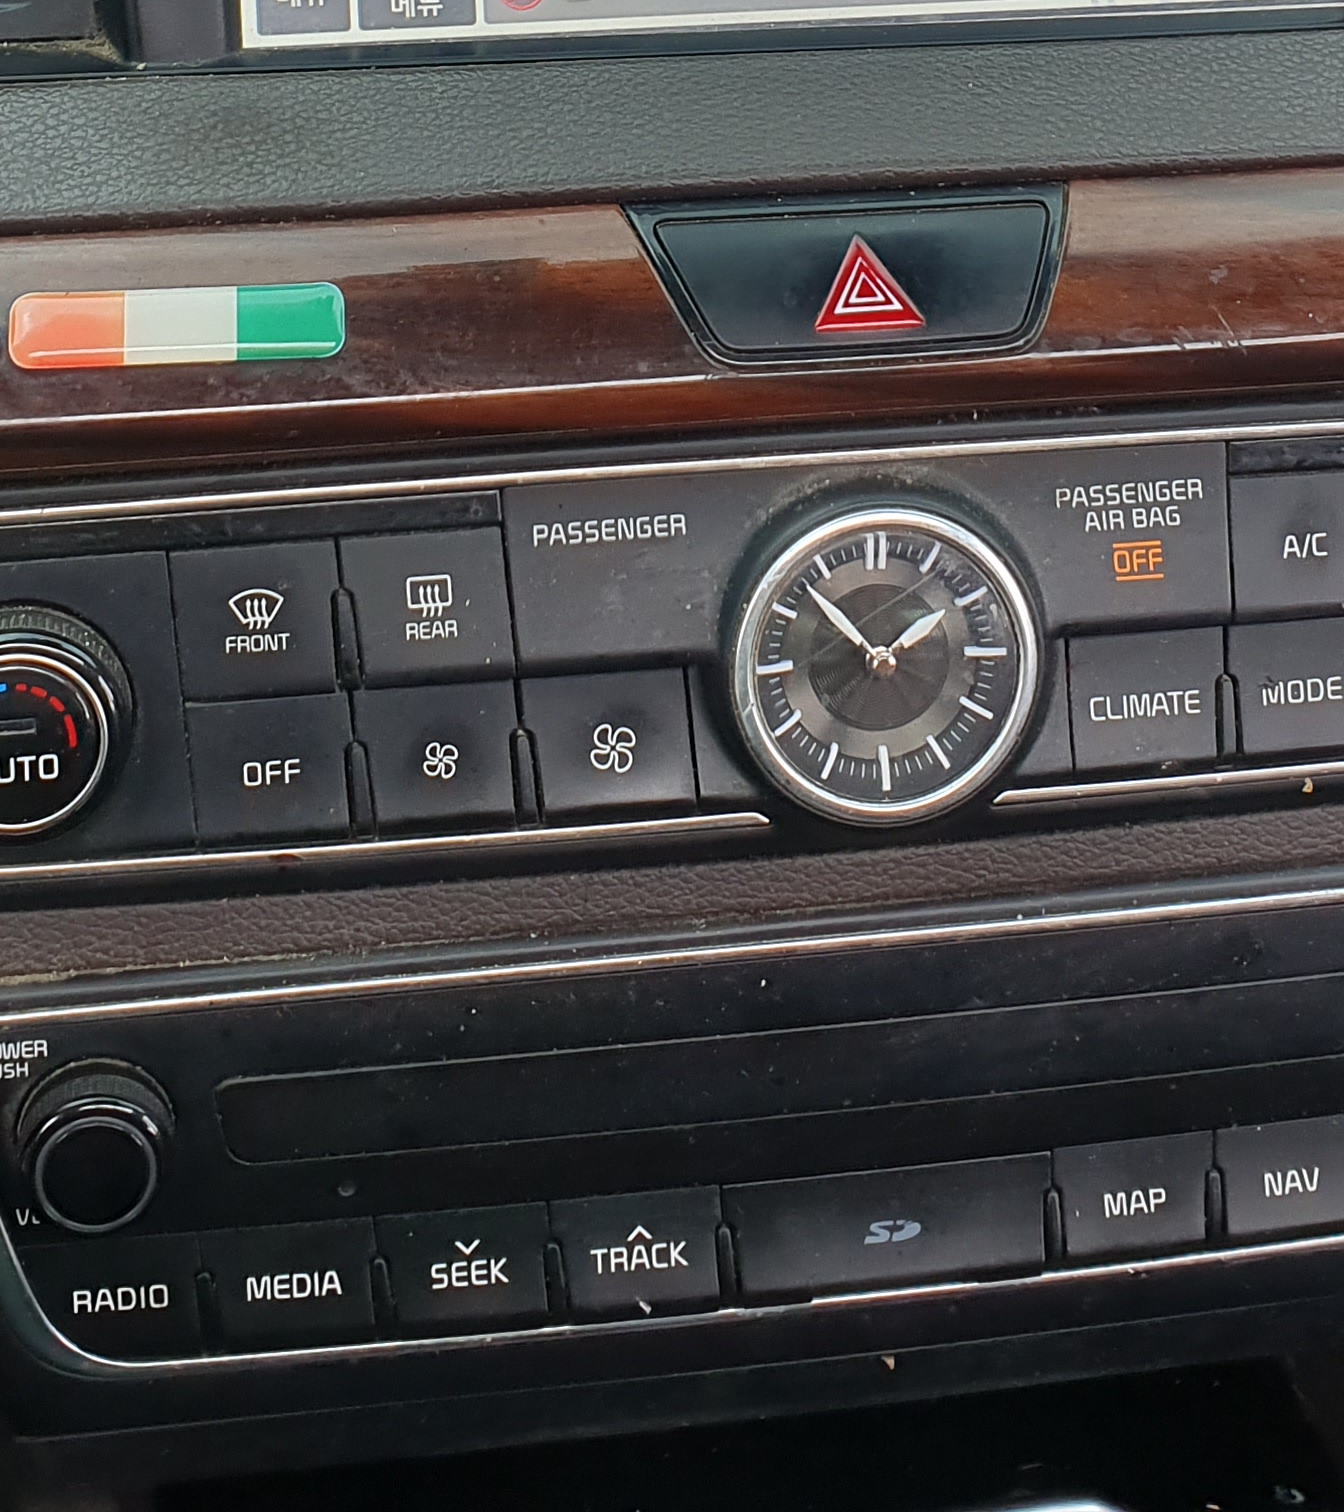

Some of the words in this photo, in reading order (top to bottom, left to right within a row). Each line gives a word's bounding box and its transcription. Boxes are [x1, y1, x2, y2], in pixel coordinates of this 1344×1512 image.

[1056, 478, 1203, 509] PASSENGER
[532, 514, 687, 547] PASSENGER
[1085, 510, 1125, 532] AIR
[1132, 506, 1181, 529] BAG
[1283, 532, 1329, 559] A/C
[1113, 548, 1163, 574] OFF
[225, 633, 290, 654] FRONT
[405, 620, 458, 641] REAR
[1089, 690, 1202, 722] CLIMATE
[1262, 676, 1343, 707] MODE
[243, 759, 302, 787] OFF
[1263, 1167, 1320, 1197] NAV
[1103, 1188, 1167, 1218] MAP
[589, 1240, 689, 1275] TRACK
[246, 1270, 343, 1302] MEDIA
[430, 1257, 509, 1290] SEEK
[72, 1284, 169, 1314] RADIO
